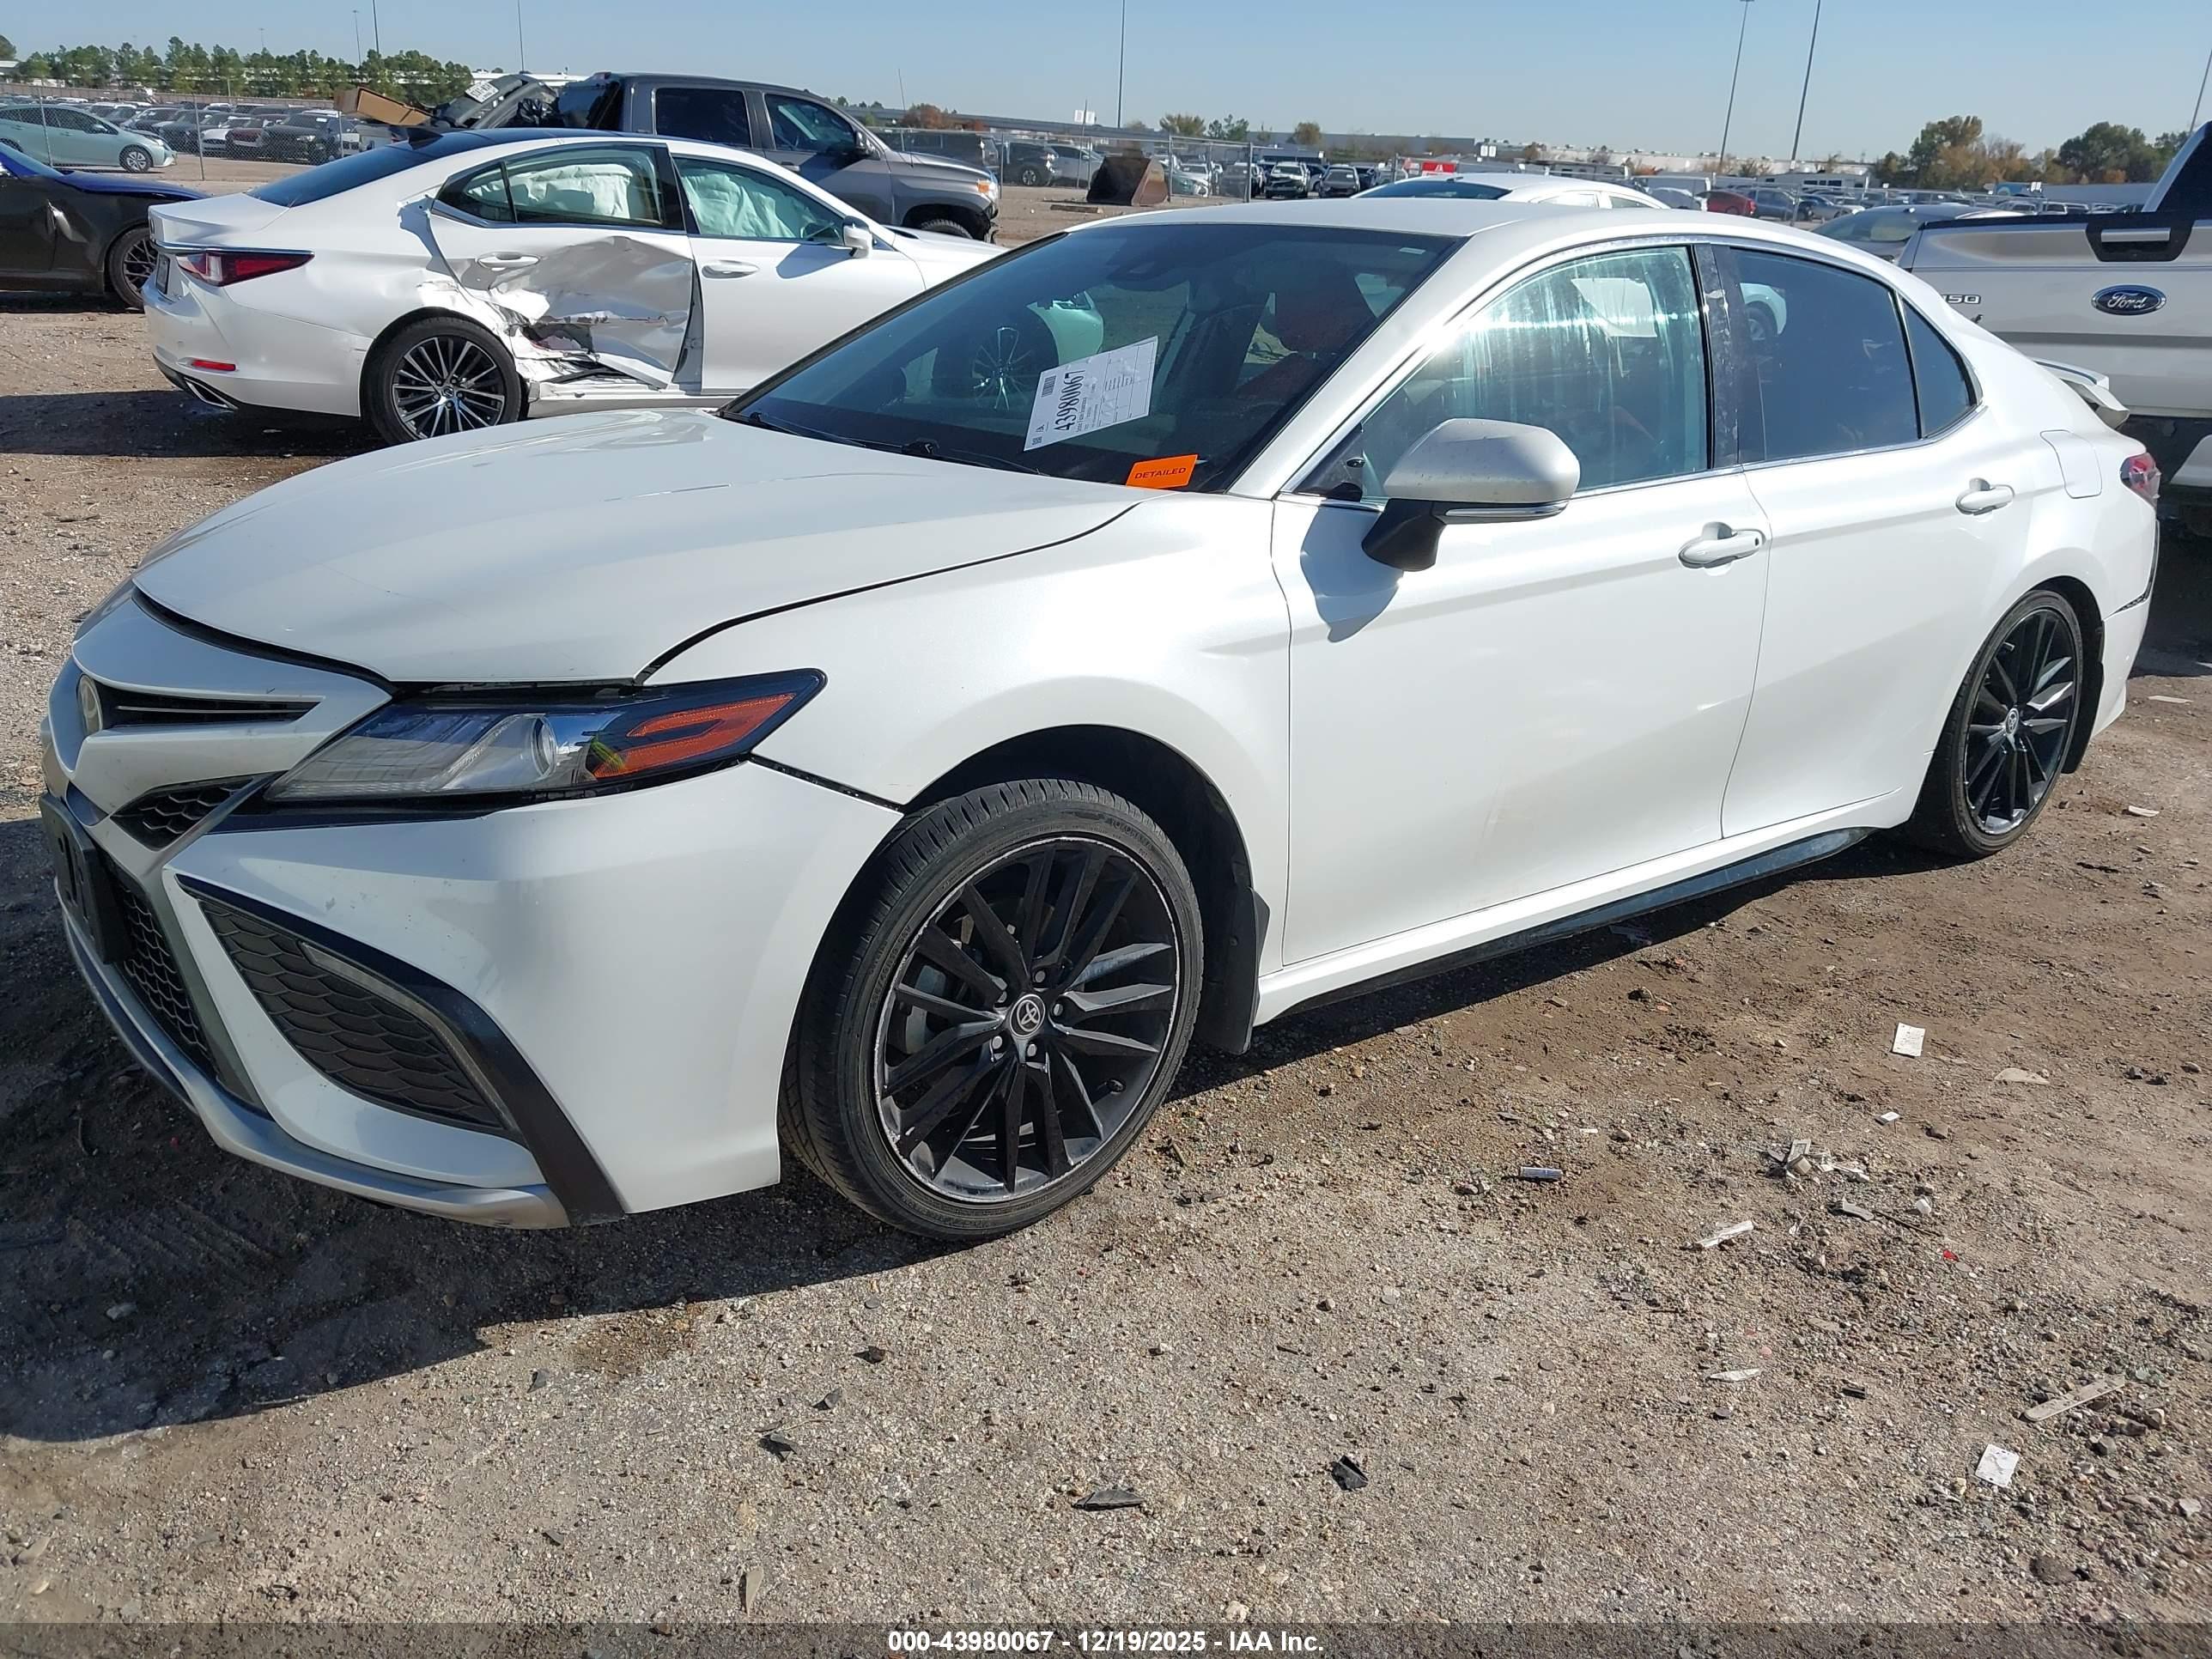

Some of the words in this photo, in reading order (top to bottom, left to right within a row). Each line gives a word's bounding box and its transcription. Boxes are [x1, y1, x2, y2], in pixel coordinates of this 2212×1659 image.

[2107, 292, 2148, 308] Ford
[1054, 370, 1086, 431] 43980067
[1134, 467, 1187, 479] DETAILED
